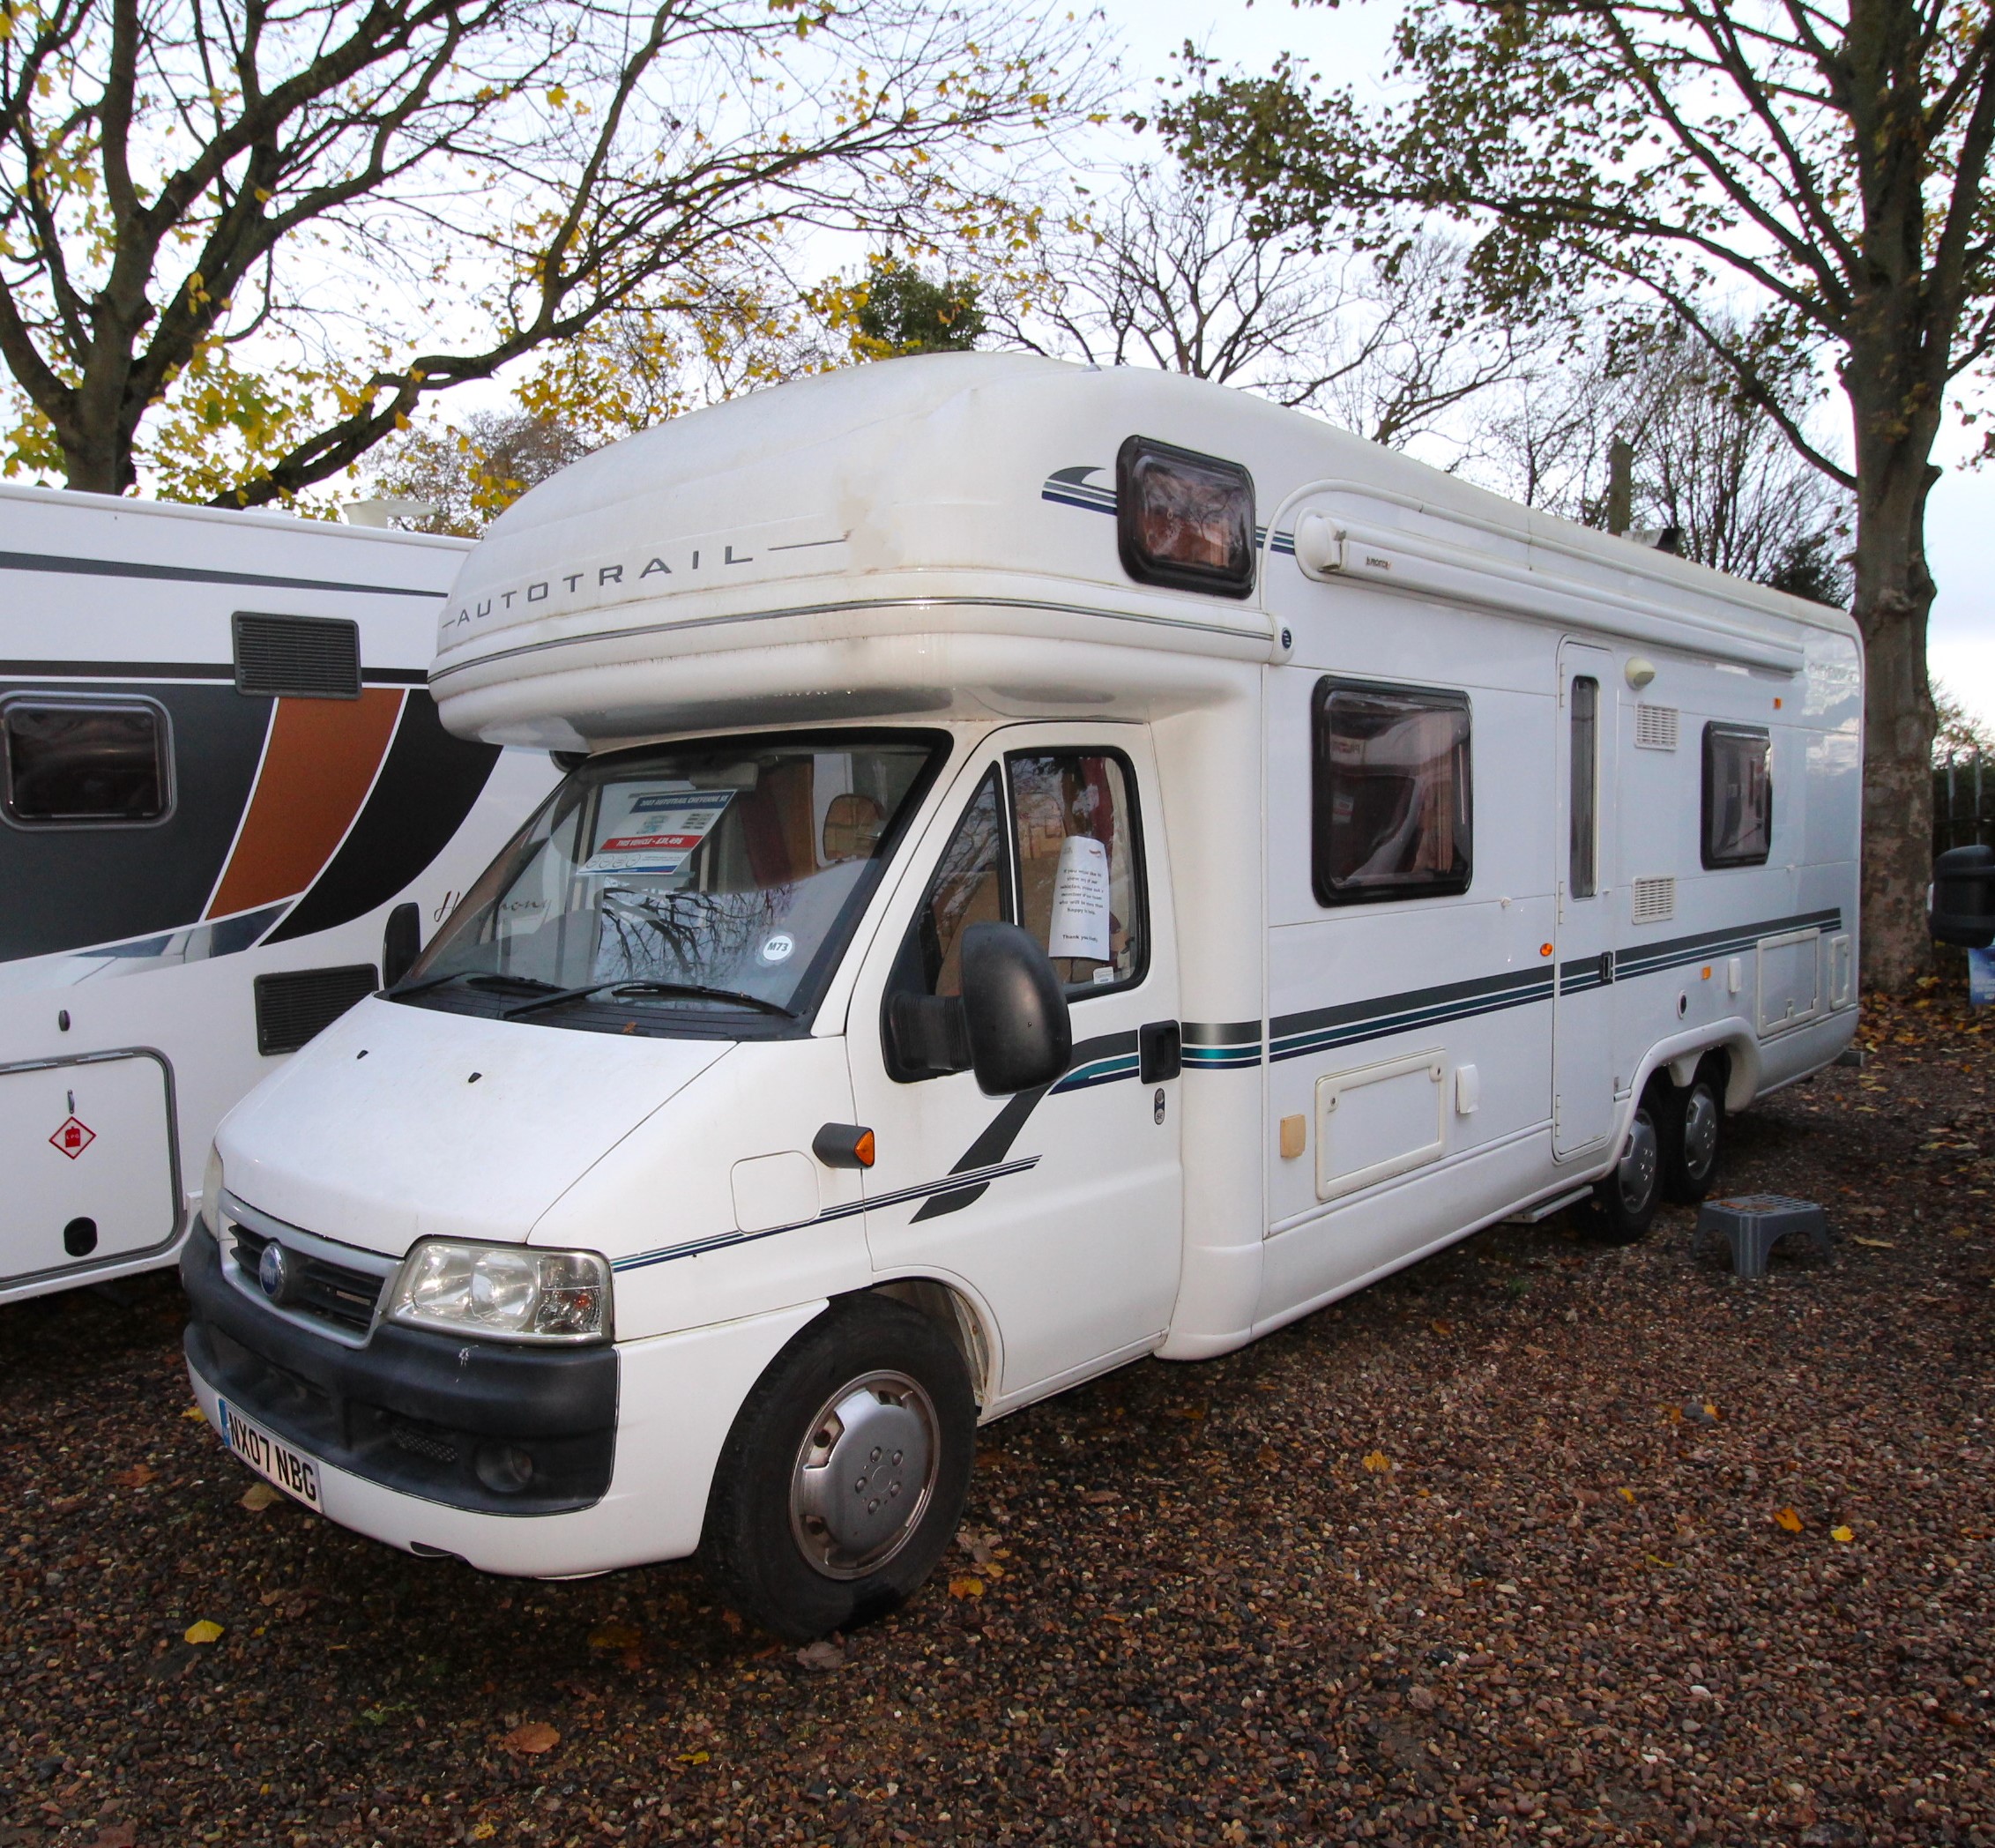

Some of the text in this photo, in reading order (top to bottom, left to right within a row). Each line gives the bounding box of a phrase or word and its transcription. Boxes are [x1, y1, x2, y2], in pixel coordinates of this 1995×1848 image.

[457, 546, 753, 627] AUTOTRAIL
[767, 942, 789, 952] M73
[228, 1412, 316, 1502] NX07 NBG
